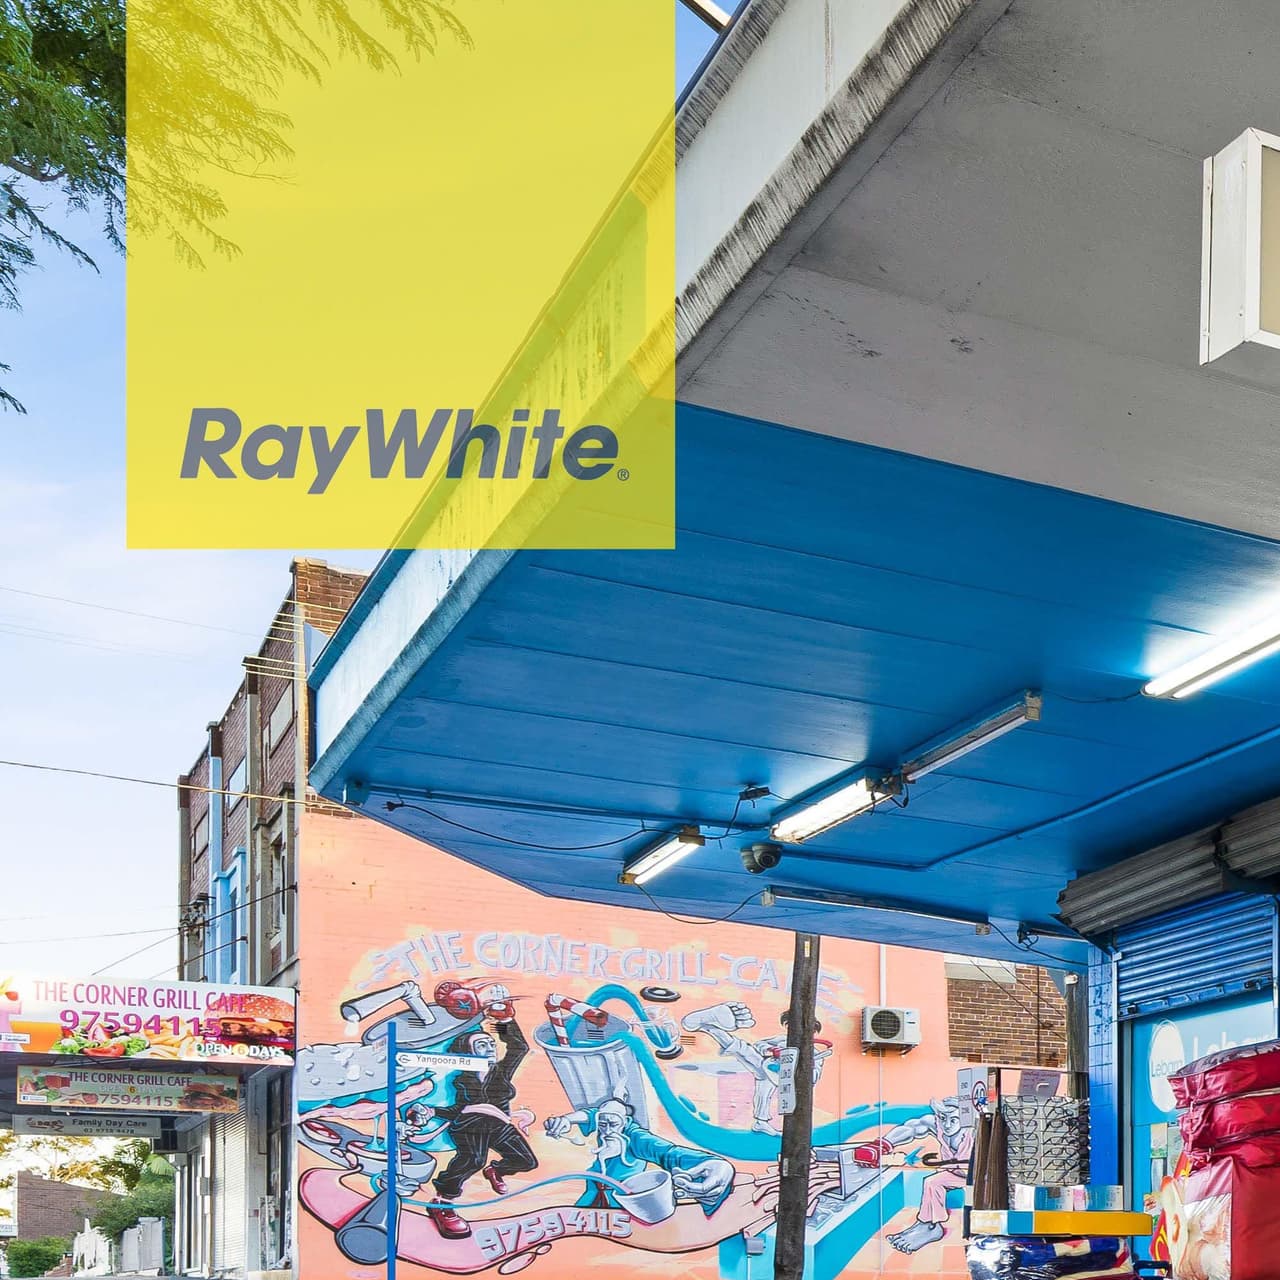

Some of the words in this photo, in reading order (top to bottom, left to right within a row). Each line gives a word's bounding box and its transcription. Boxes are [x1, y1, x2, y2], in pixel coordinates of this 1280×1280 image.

[394, 932, 472, 978] THE
[472, 932, 619, 981] CORNER
[619, 948, 719, 986] GRILL
[34, 980, 68, 1002] THE
[74, 983, 149, 1008] CORNER
[153, 988, 201, 1010] GRILL
[206, 992, 247, 1014] CAFE
[60, 1009, 221, 1037] 97594115
[195, 1042, 232, 1056] OPEN
[250, 1045, 285, 1058] DAYS
[416, 1055, 457, 1065] Yangoora
[459, 1057, 471, 1066] Rd
[68, 1071, 89, 1082] THE
[91, 1073, 134, 1086] CORNER
[137, 1075, 166, 1087] GRILL
[167, 1076, 193, 1087] CAFE
[72, 1119, 103, 1128] Family
[106, 1120, 124, 1128] Day
[127, 1120, 148, 1128] Care
